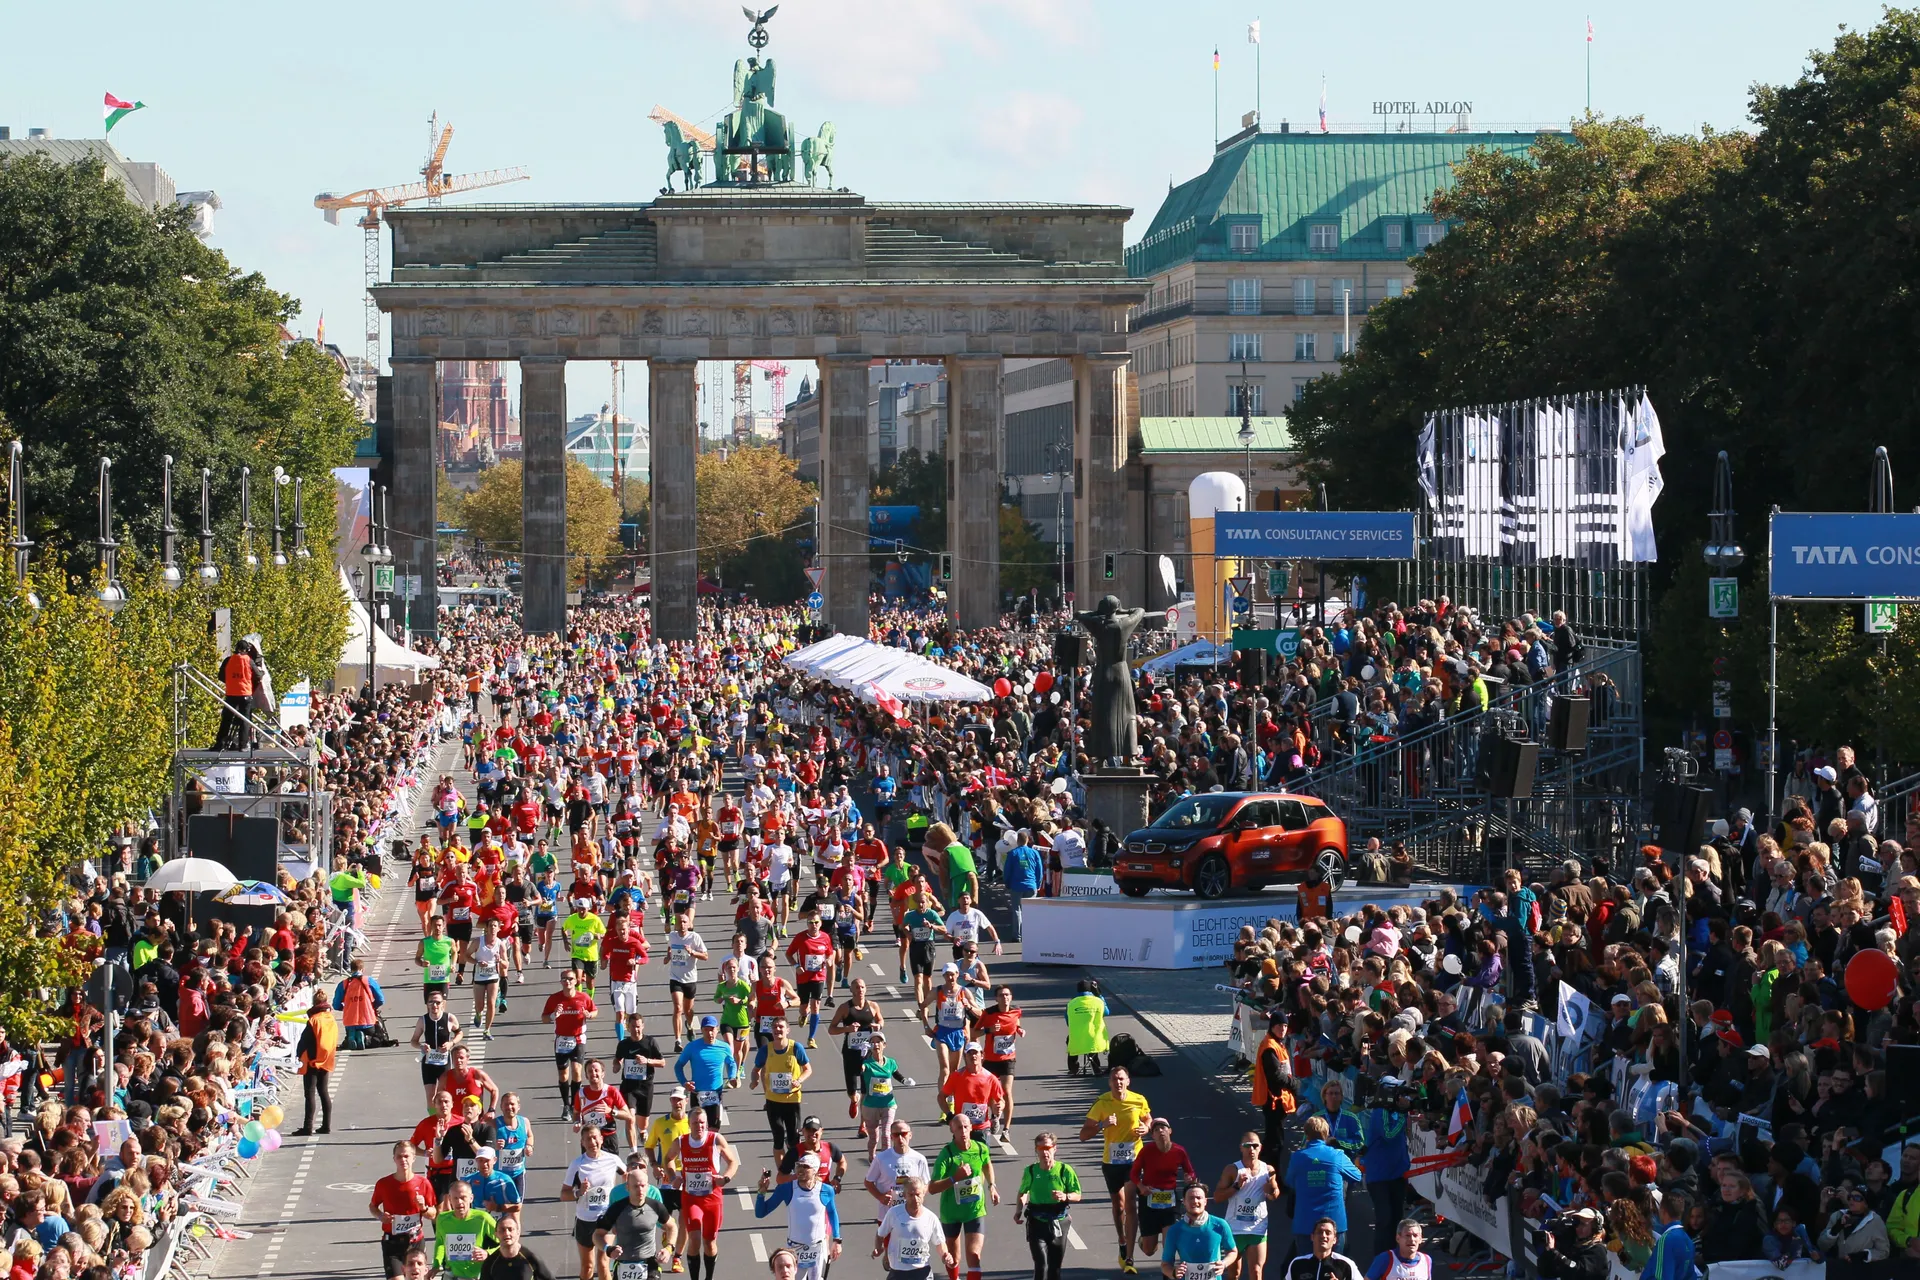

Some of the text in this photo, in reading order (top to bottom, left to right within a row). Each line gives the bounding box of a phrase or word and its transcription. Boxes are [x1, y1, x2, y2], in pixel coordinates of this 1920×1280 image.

[1372, 101, 1473, 114] HOTEL ADLON
[1225, 528, 1403, 541] TATA CONSULTANCY SERVICES
[1791, 546, 1858, 565] TATA
[282, 695, 307, 705] km 42
[1192, 933, 1213, 948] DER
[1039, 951, 1075, 959] www.bmw-i.de
[1102, 947, 1128, 960] BMW
[688, 1179, 709, 1189] 29747
[959, 1184, 979, 1196] 697
[449, 1243, 472, 1252] 30020
[621, 1270, 643, 1280] 5412
